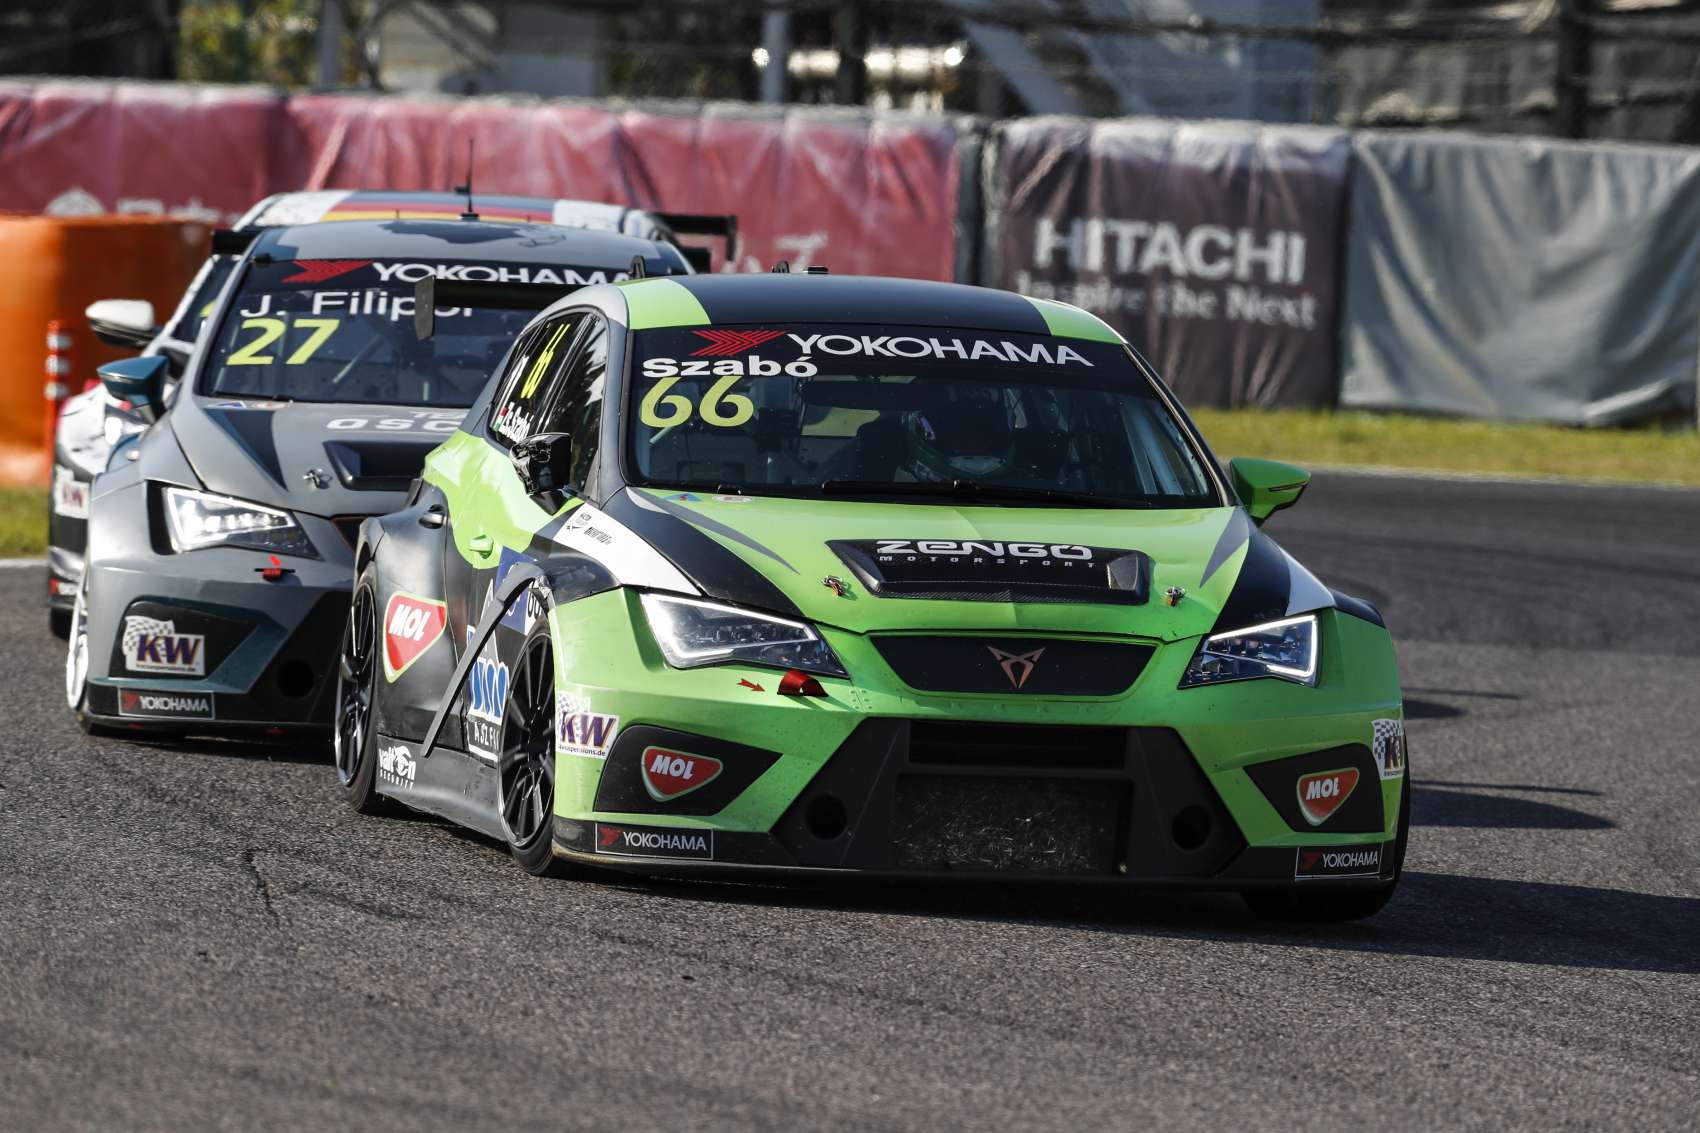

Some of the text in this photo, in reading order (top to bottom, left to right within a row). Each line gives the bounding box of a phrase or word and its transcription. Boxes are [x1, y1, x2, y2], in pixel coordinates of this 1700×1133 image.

[1034, 216, 1305, 284] HITACHI
[240, 295, 286, 316] J.
[312, 292, 473, 321] Filip
[226, 318, 340, 365] 27
[786, 333, 1095, 367] YOKOHAMA
[642, 355, 818, 378] Szabó
[639, 376, 754, 428] 66
[879, 556, 1095, 568] MOTORSPORT
[389, 604, 430, 641] MOL
[137, 634, 201, 665] KW
[139, 695, 209, 711] YOKOHAMA
[560, 711, 616, 747] KW
[651, 755, 693, 779] MOL
[1306, 778, 1340, 800] MOL
[623, 831, 707, 851] YOKOHAMA
[1322, 851, 1378, 868] YOKOHAMA
